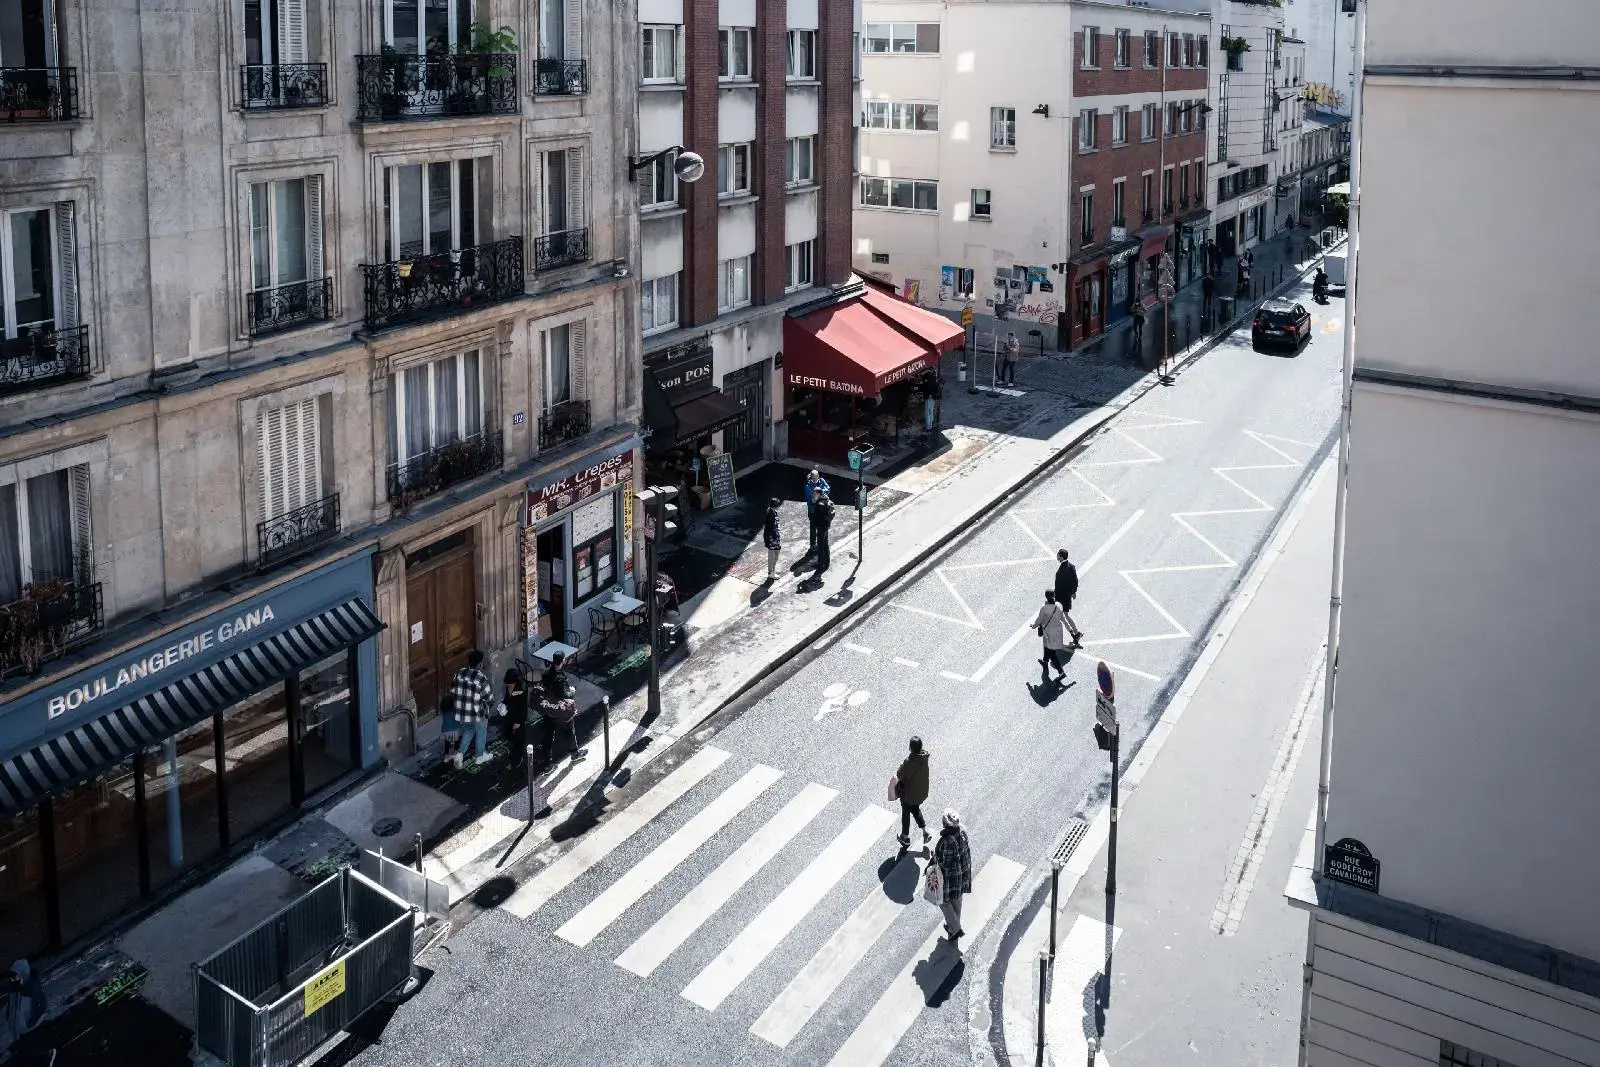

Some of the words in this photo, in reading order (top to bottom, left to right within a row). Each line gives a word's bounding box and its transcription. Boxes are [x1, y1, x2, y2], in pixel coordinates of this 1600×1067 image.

[685, 364, 710, 382] POS
[790, 374, 801, 384] LE
[803, 378, 827, 388] PETIT
[48, 629, 214, 720] BOULANGERIE
[217, 604, 275, 643] GANA
[1331, 860, 1373, 878] GODEFROY
[1344, 855, 1361, 867] RUE
[1329, 867, 1374, 886] CAVAIGNAC
